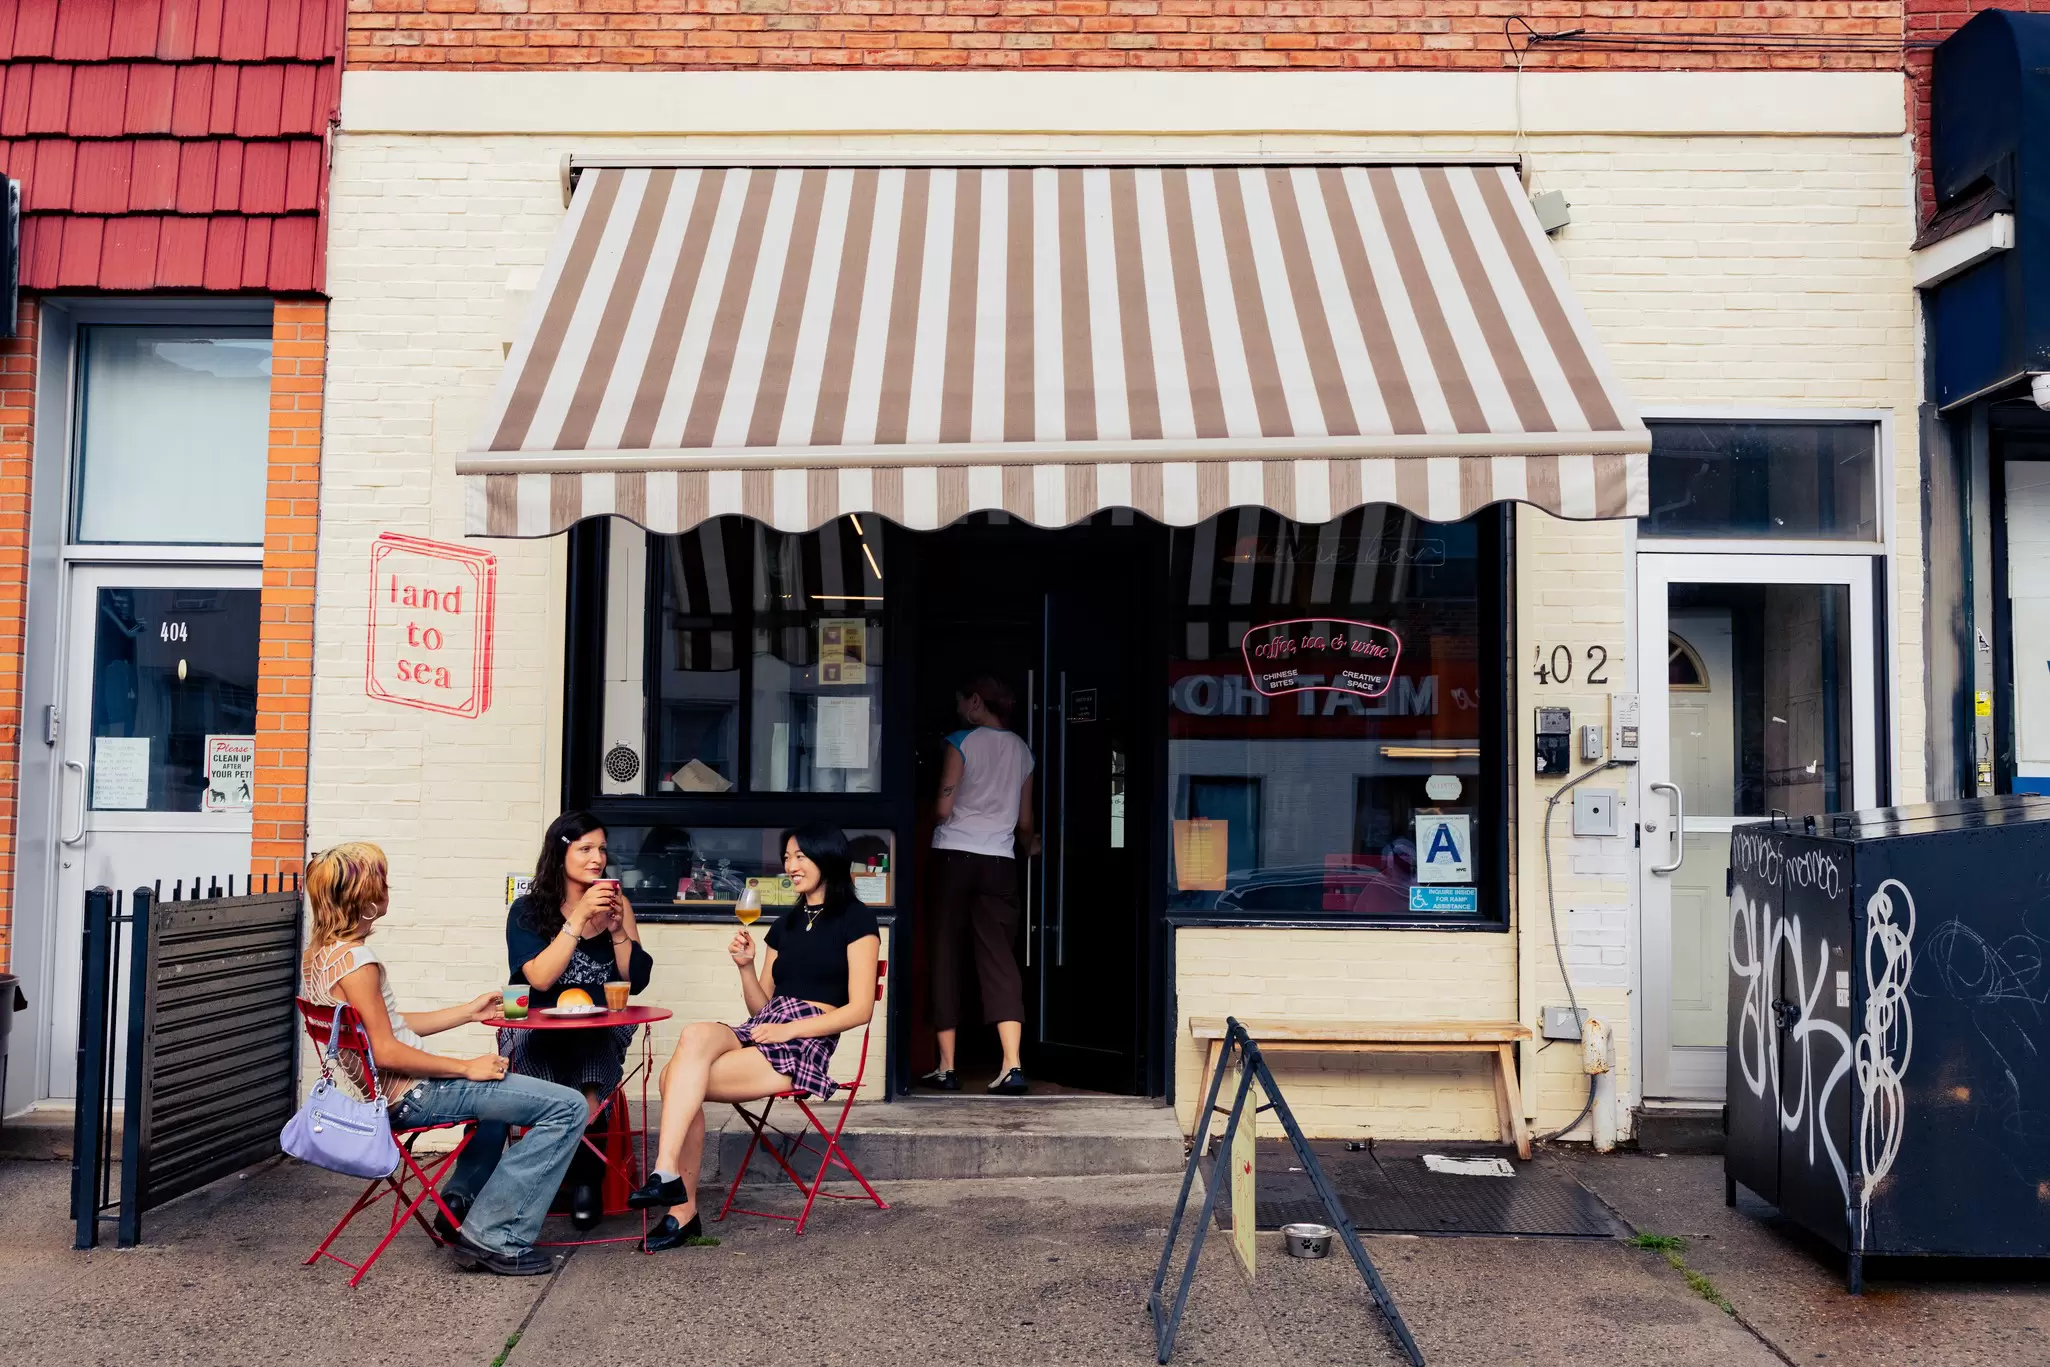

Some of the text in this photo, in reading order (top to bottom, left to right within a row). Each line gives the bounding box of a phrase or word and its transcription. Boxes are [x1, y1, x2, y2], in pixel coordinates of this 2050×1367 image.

[391, 574, 463, 615] land
[160, 621, 188, 642] 404
[407, 621, 443, 651] to
[1254, 634, 1390, 659] coffee, tea, & wine
[1533, 644, 1608, 684] 402
[397, 659, 451, 689] sea
[1262, 669, 1299, 682] CHINESE
[1342, 670, 1382, 683] CREATIVE
[1270, 678, 1294, 689] BITES
[1347, 679, 1374, 691] SPACE
[215, 742, 249, 753] Please
[213, 754, 252, 762] CLEAN UP
[212, 770, 252, 778] YOUR PET!
[1425, 823, 1462, 863] A
